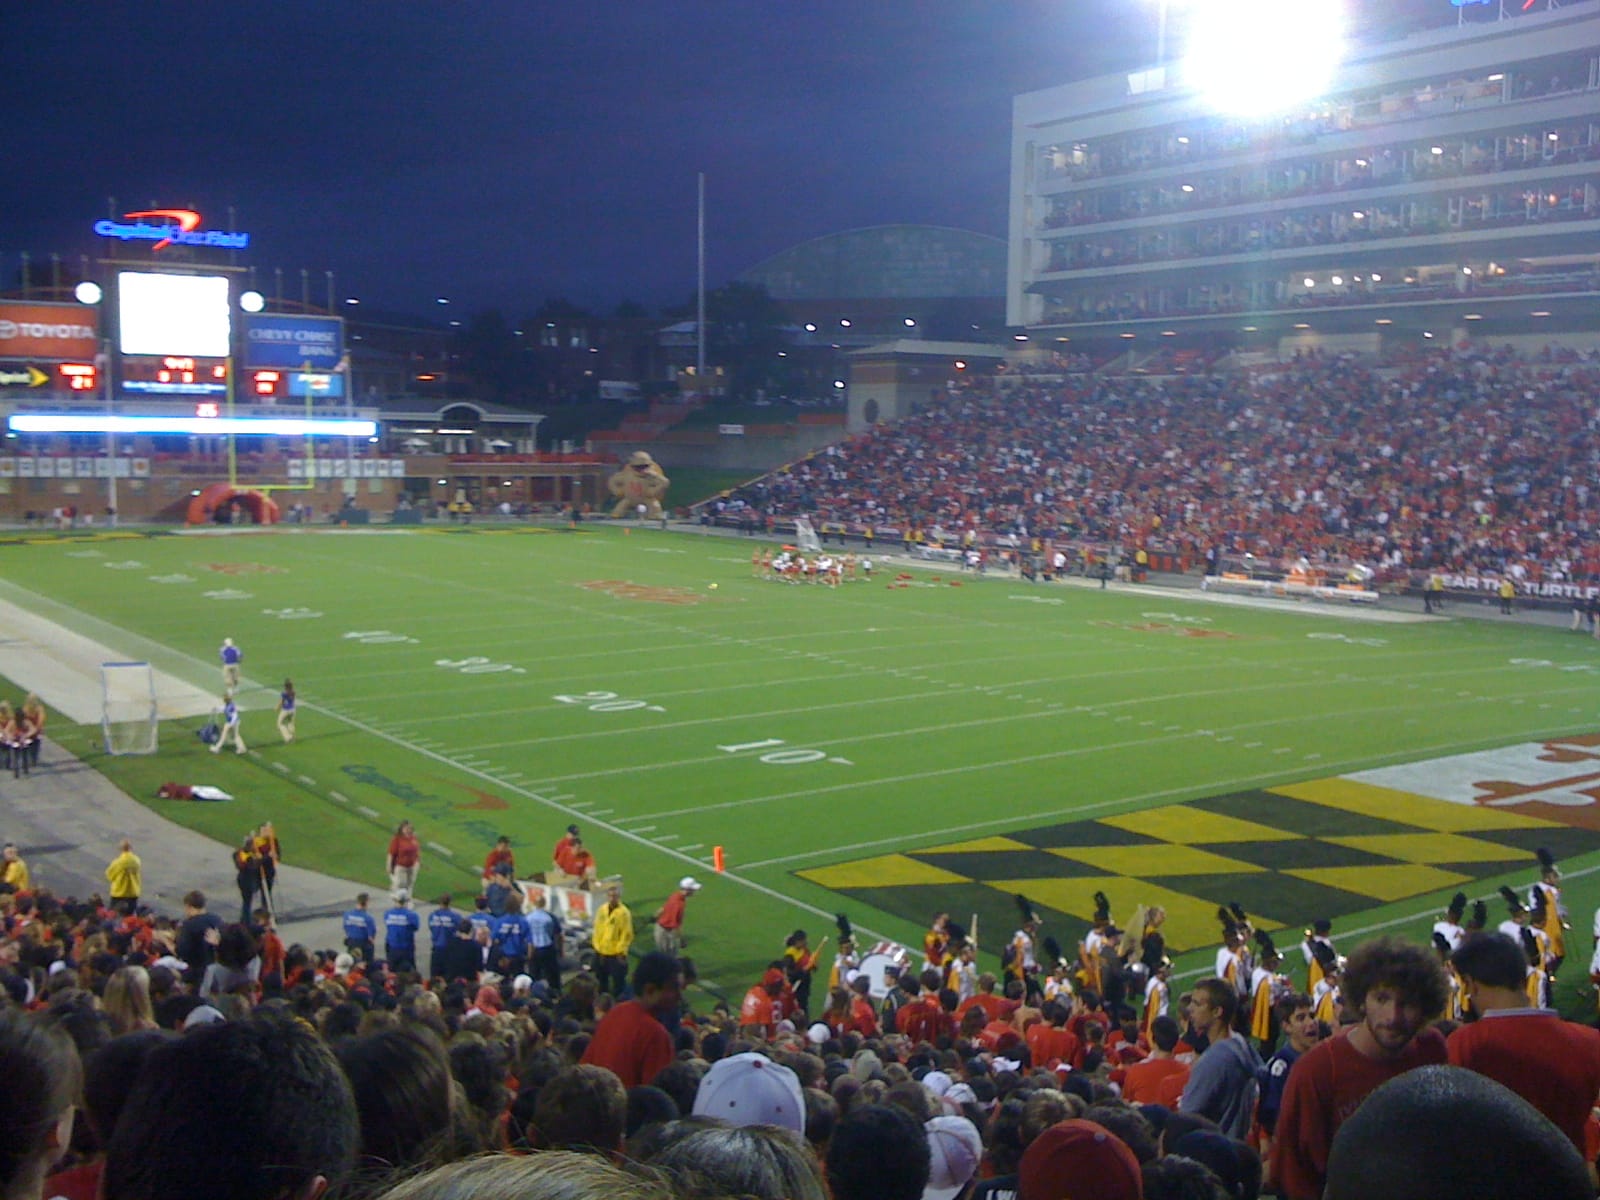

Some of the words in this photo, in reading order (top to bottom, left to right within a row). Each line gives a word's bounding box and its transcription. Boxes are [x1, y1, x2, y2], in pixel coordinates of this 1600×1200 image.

[19, 323, 95, 339] TOYOTA
[1432, 574, 1479, 589] EAR
[1523, 581, 1600, 600] TURTLE
[552, 690, 648, 711] 20
[716, 738, 827, 765] 10
